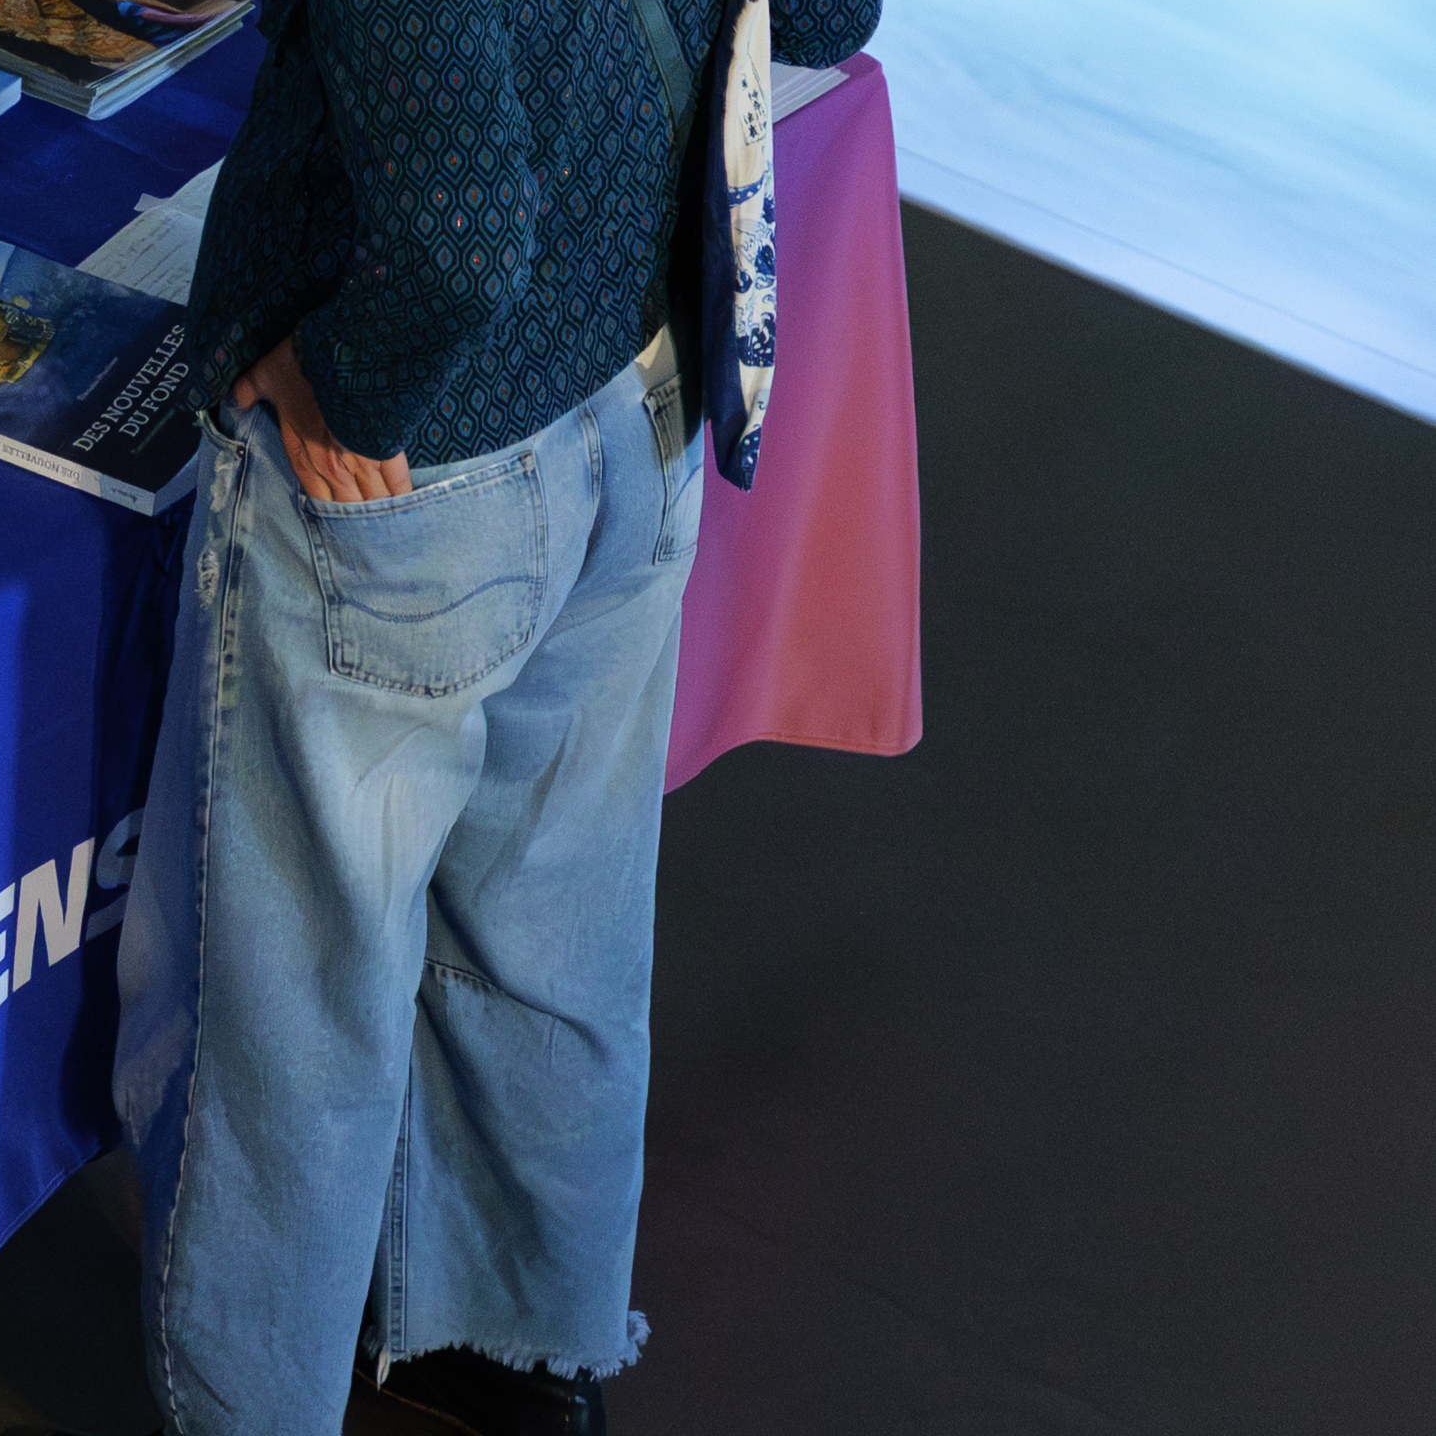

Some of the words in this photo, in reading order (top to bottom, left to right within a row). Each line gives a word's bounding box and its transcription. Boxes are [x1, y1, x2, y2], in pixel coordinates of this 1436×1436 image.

[73, 421, 110, 451] DES
[100, 324, 185, 423] NOUVELLES
[118, 410, 149, 437] DU
[141, 363, 189, 412] FOND
[0, 443, 60, 473] NOUVELLES
